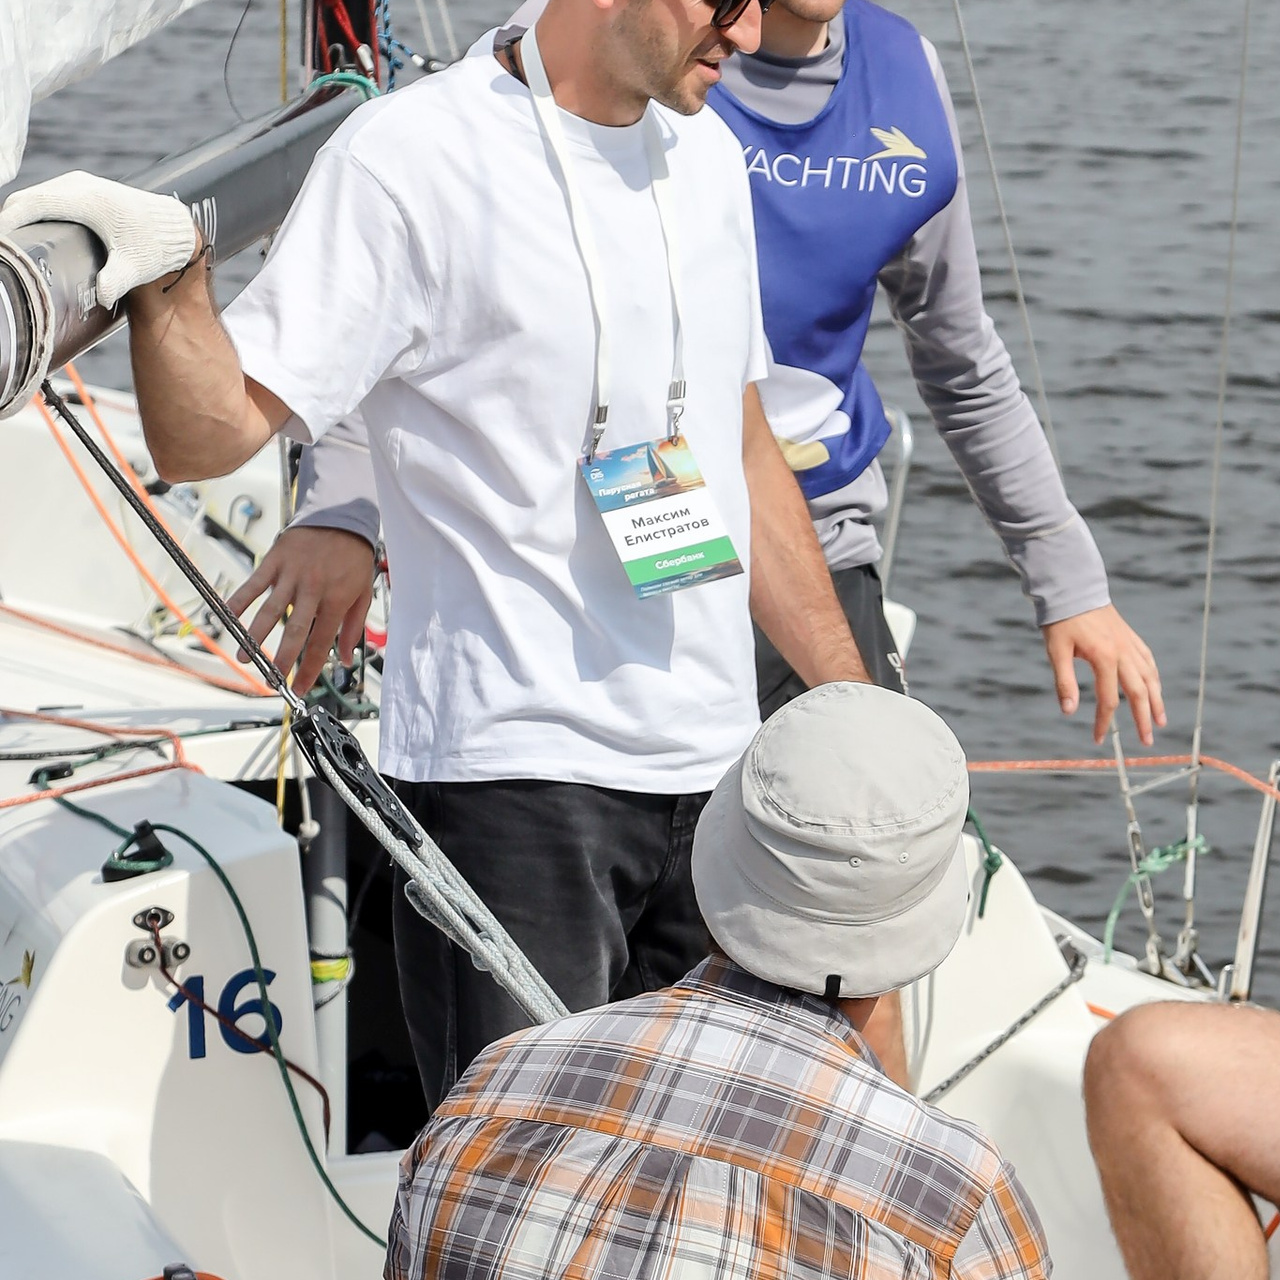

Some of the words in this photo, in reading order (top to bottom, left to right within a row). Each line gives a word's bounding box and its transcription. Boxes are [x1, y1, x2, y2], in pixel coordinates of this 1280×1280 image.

[598, 481, 642, 497] Парусная
[631, 508, 691, 529] Максим
[624, 518, 710, 547] Елистратов
[655, 551, 705, 570] Сбербанк
[167, 968, 282, 1060] 16
